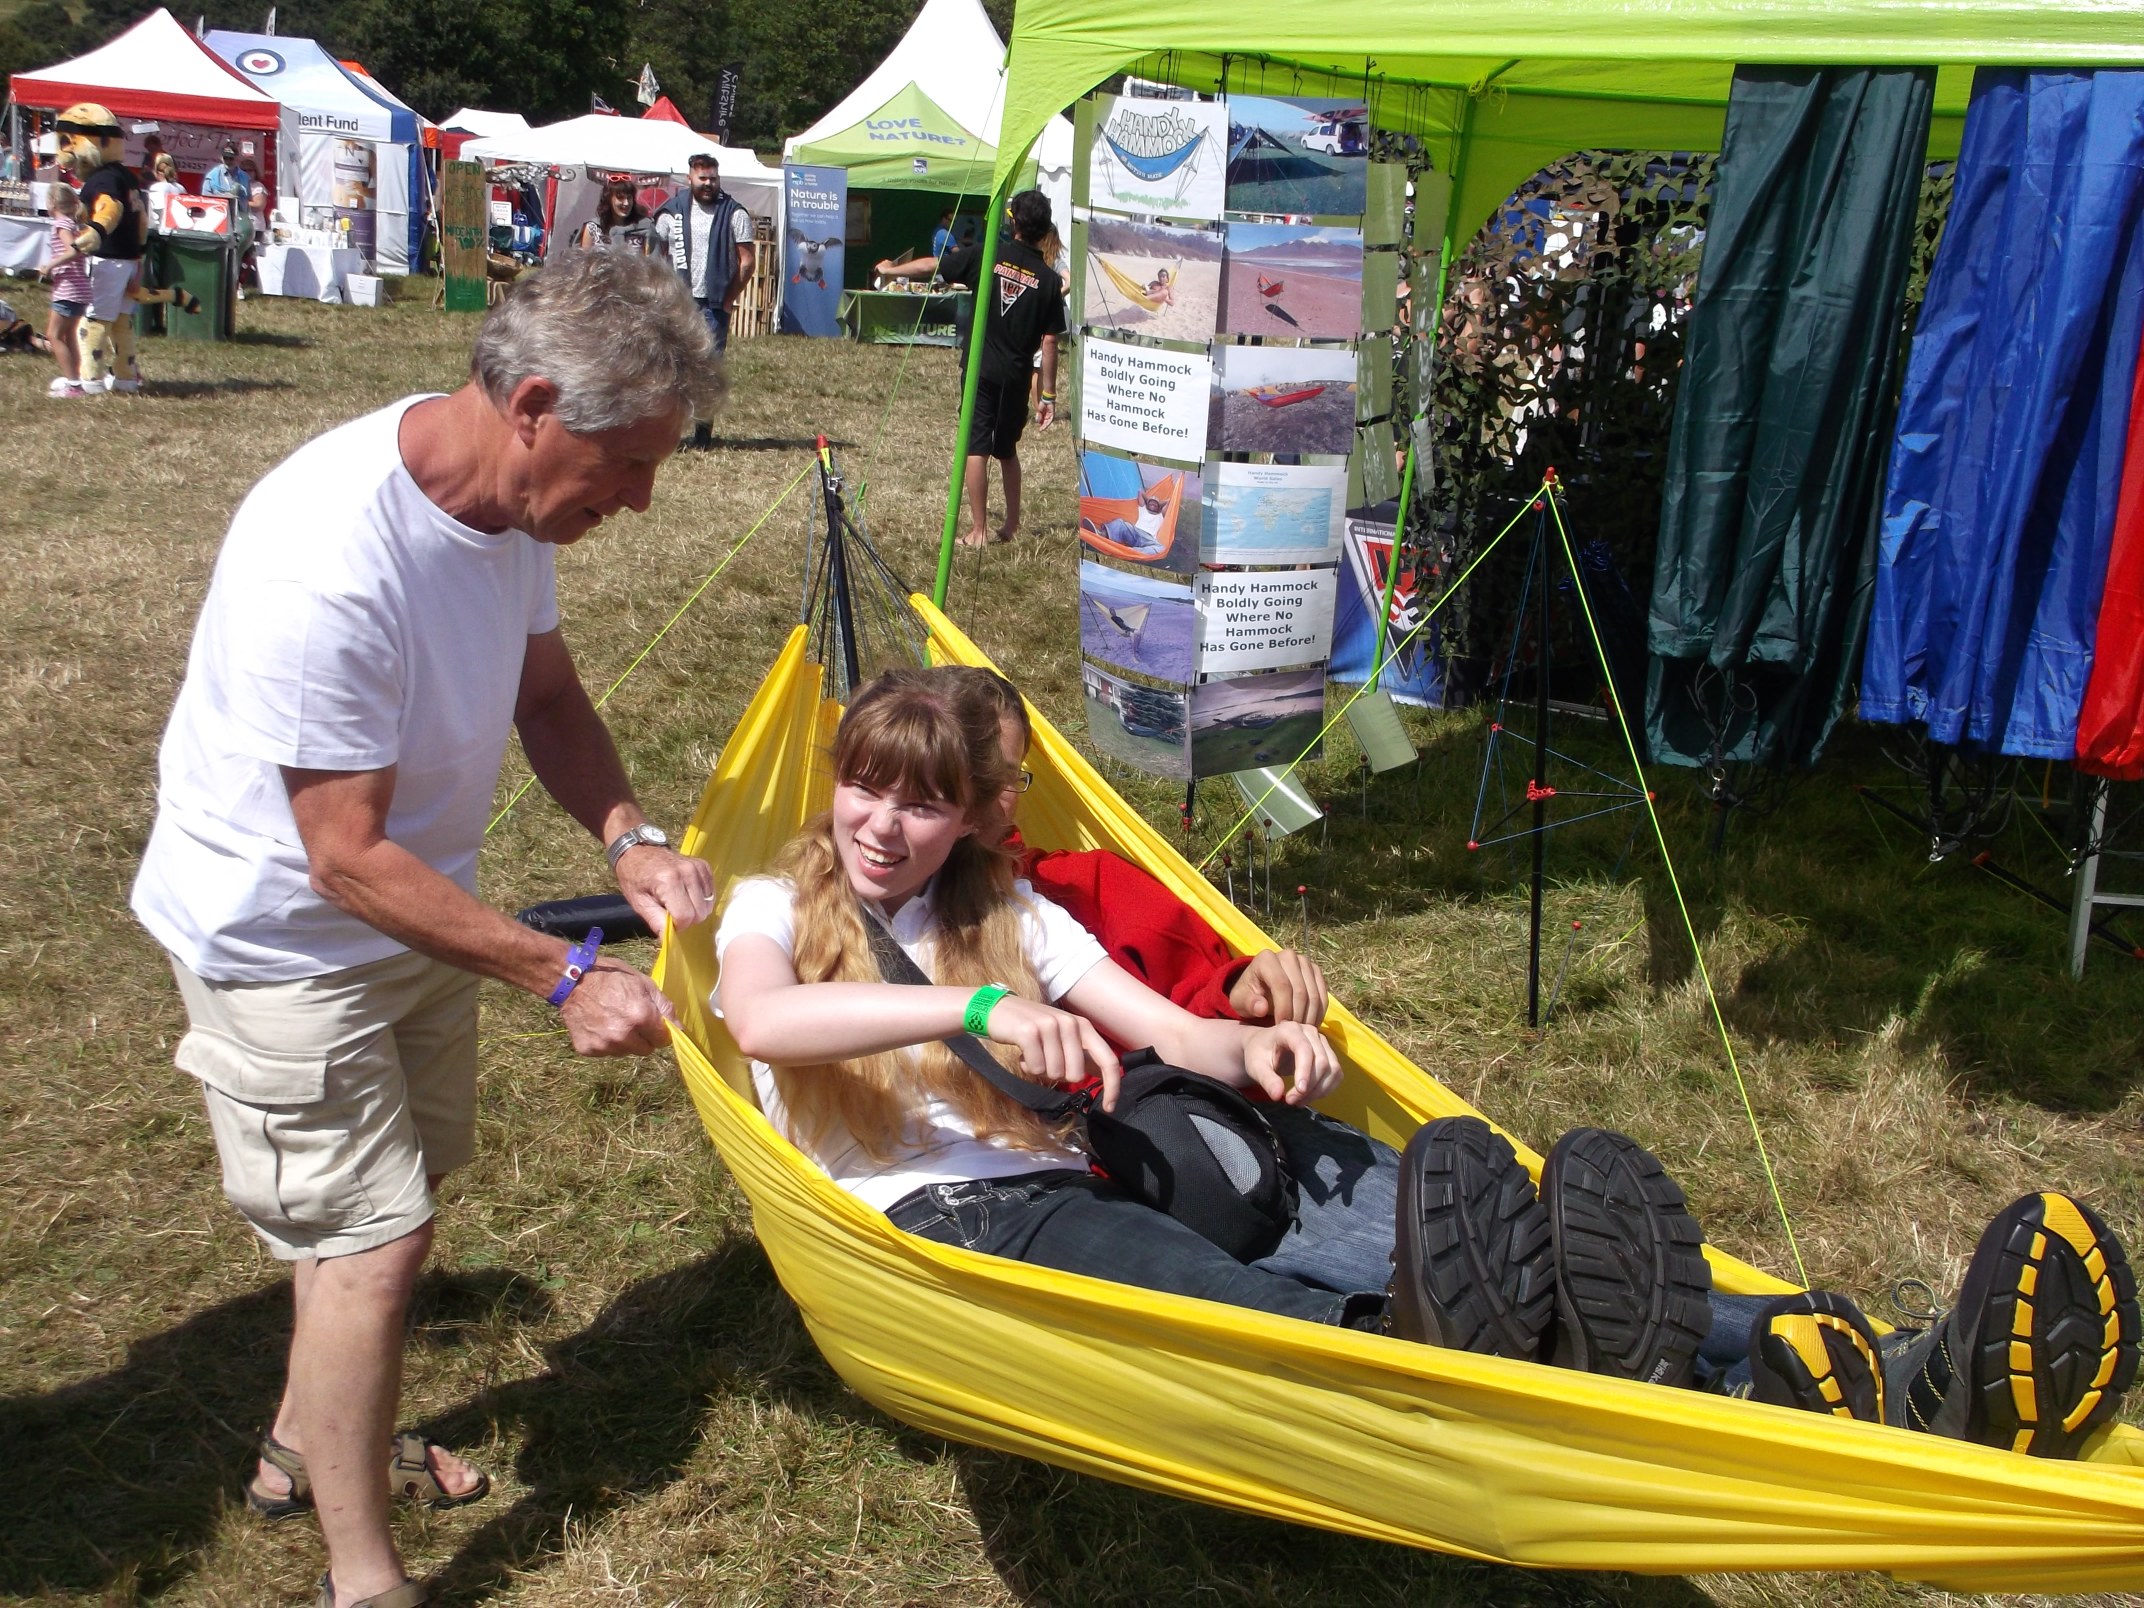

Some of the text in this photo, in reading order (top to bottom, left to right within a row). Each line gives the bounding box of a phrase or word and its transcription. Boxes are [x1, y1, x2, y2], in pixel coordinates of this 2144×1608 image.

[298, 112, 359, 131] lent Fund
[865, 118, 922, 130] LOVE
[1120, 106, 1180, 138] HANDY
[869, 131, 967, 146] NATURE?
[1107, 117, 1199, 158] HAMMOCK
[448, 162, 481, 176] OPEN
[790, 188, 838, 201] Nature is
[790, 198, 840, 211] in trouble
[993, 263, 1040, 290] PAINTBALL
[899, 323, 957, 337] NATURE
[1090, 348, 1192, 376] Handy Hammock
[1100, 367, 1176, 391] Boldly Going
[1107, 383, 1166, 403] Where No
[1106, 398, 1165, 419] Hammock
[1087, 408, 1188, 438] Has Gone Before!
[1353, 525, 1397, 538] INTERNATIONA
[1201, 580, 1318, 595] Handy Hammock
[1216, 596, 1303, 609] Boldly Going
[1226, 611, 1293, 622] Where No
[1225, 624, 1293, 637] Hammock
[1200, 634, 1316, 652] Has Gone Before!
